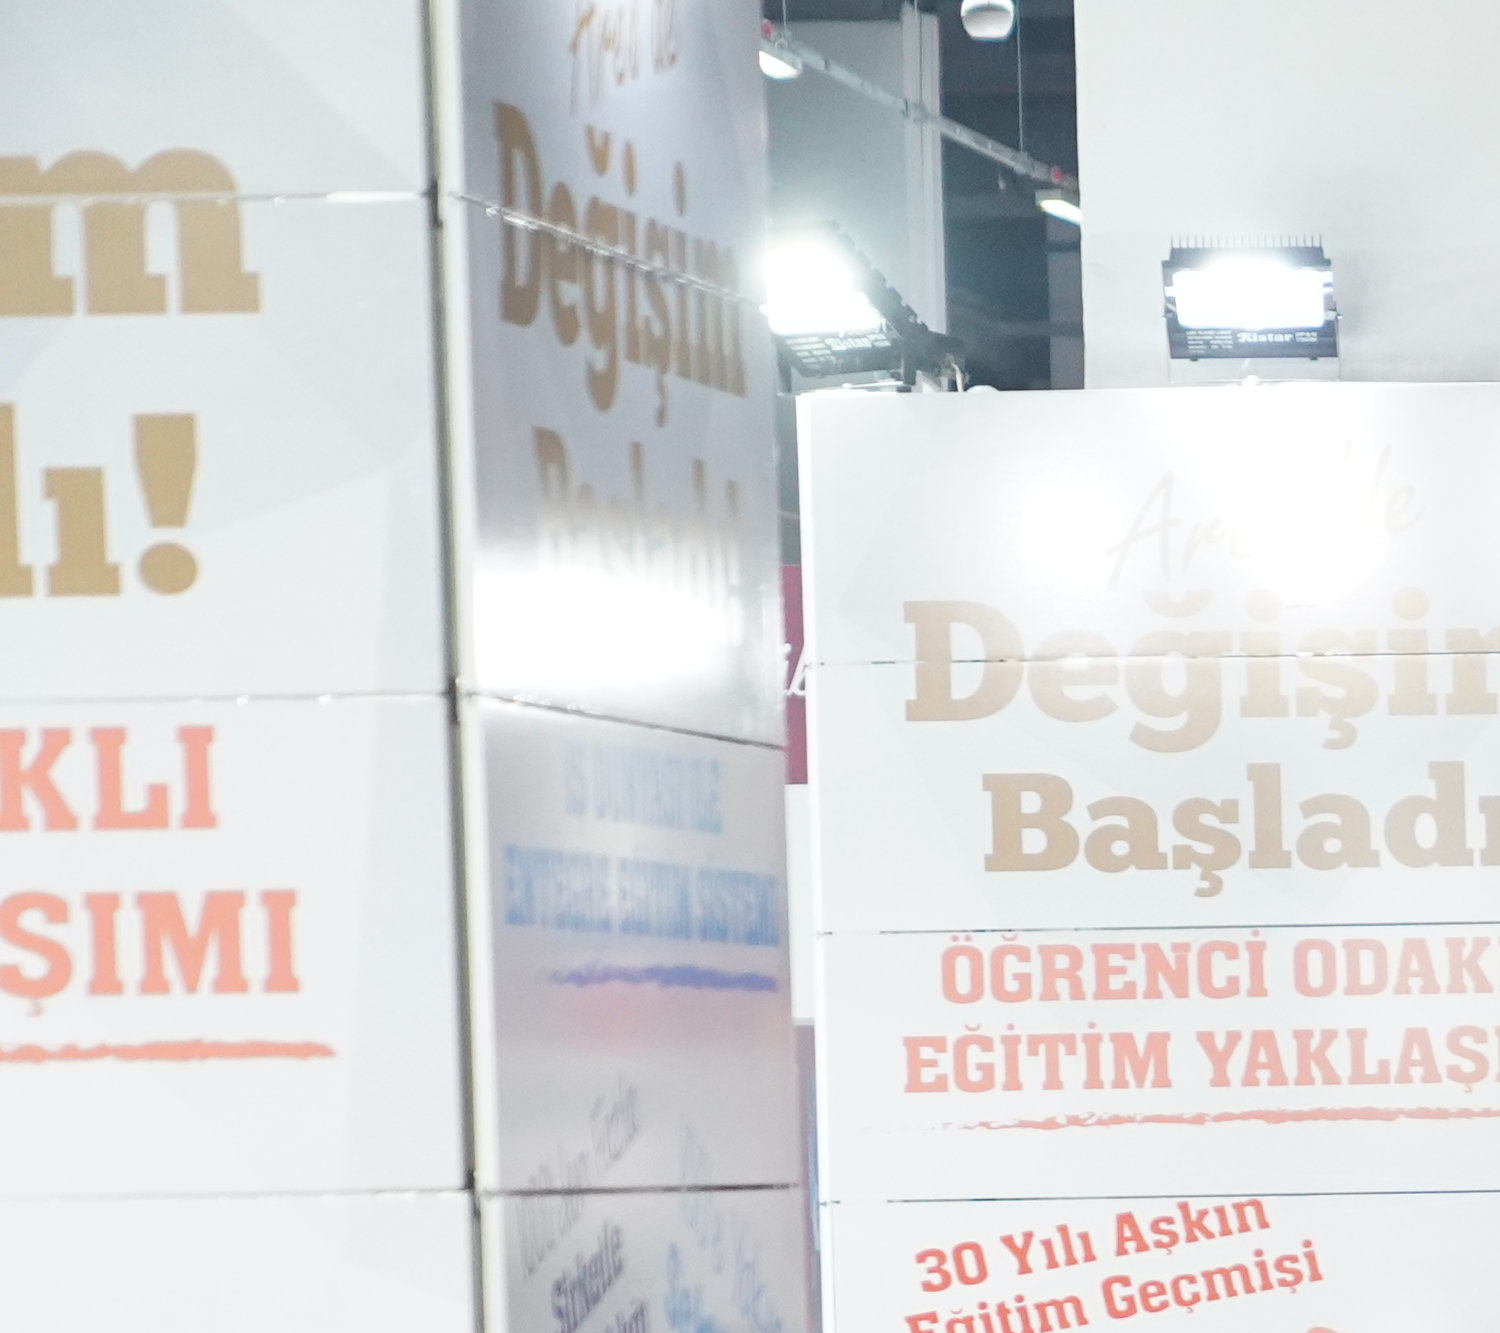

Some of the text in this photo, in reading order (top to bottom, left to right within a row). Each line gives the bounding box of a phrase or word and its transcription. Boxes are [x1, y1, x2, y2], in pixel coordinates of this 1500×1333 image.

[492, 100, 745, 427] Değişim
[941, 930, 1269, 1004] ÖĞRENCİ
[903, 1022, 1171, 1094] EĞİTİM
[916, 1199, 1270, 1293] 30 Yılı Aşkın
[1102, 1239, 1323, 1320] Geçmişi
